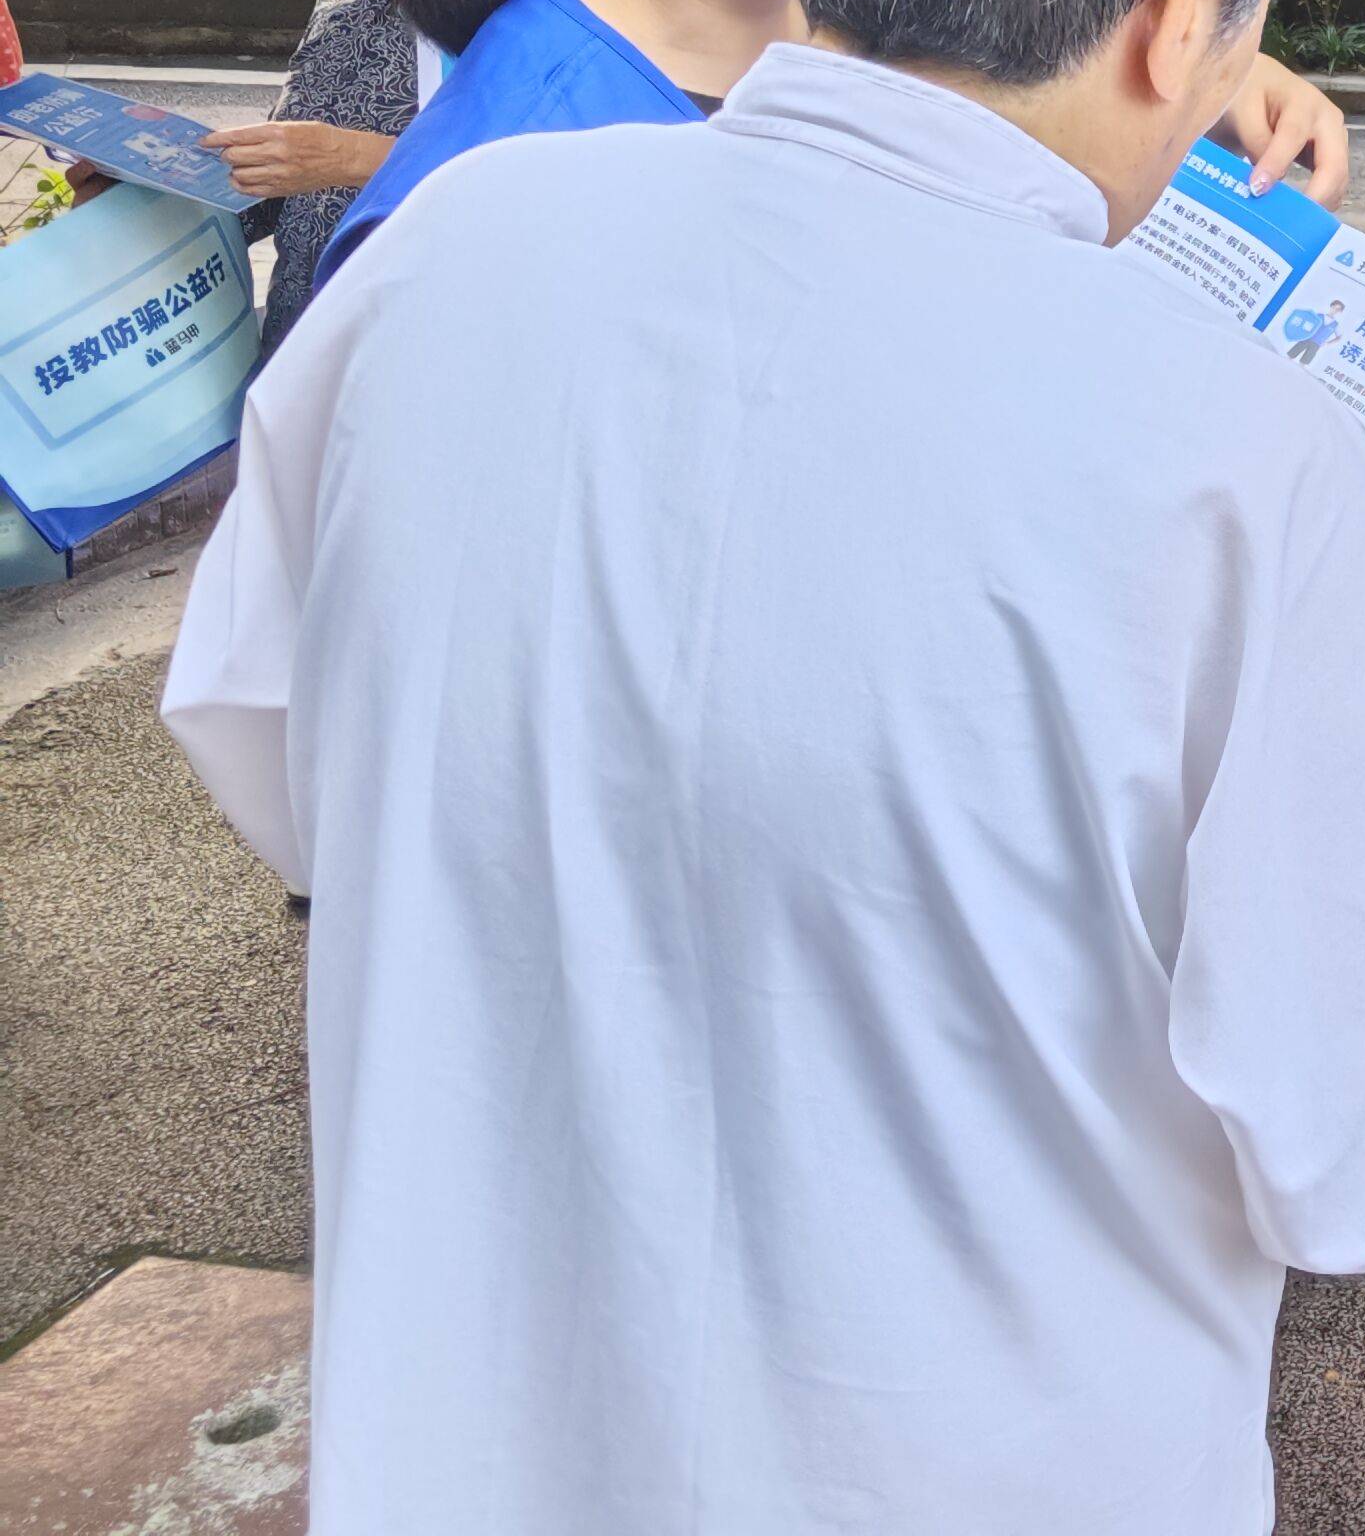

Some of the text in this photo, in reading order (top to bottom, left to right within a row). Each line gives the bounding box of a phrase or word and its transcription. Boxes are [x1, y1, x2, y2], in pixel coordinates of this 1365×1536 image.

[34, 252, 226, 396] 投教防骗公益行
[163, 322, 200, 356] 蓝马甲
